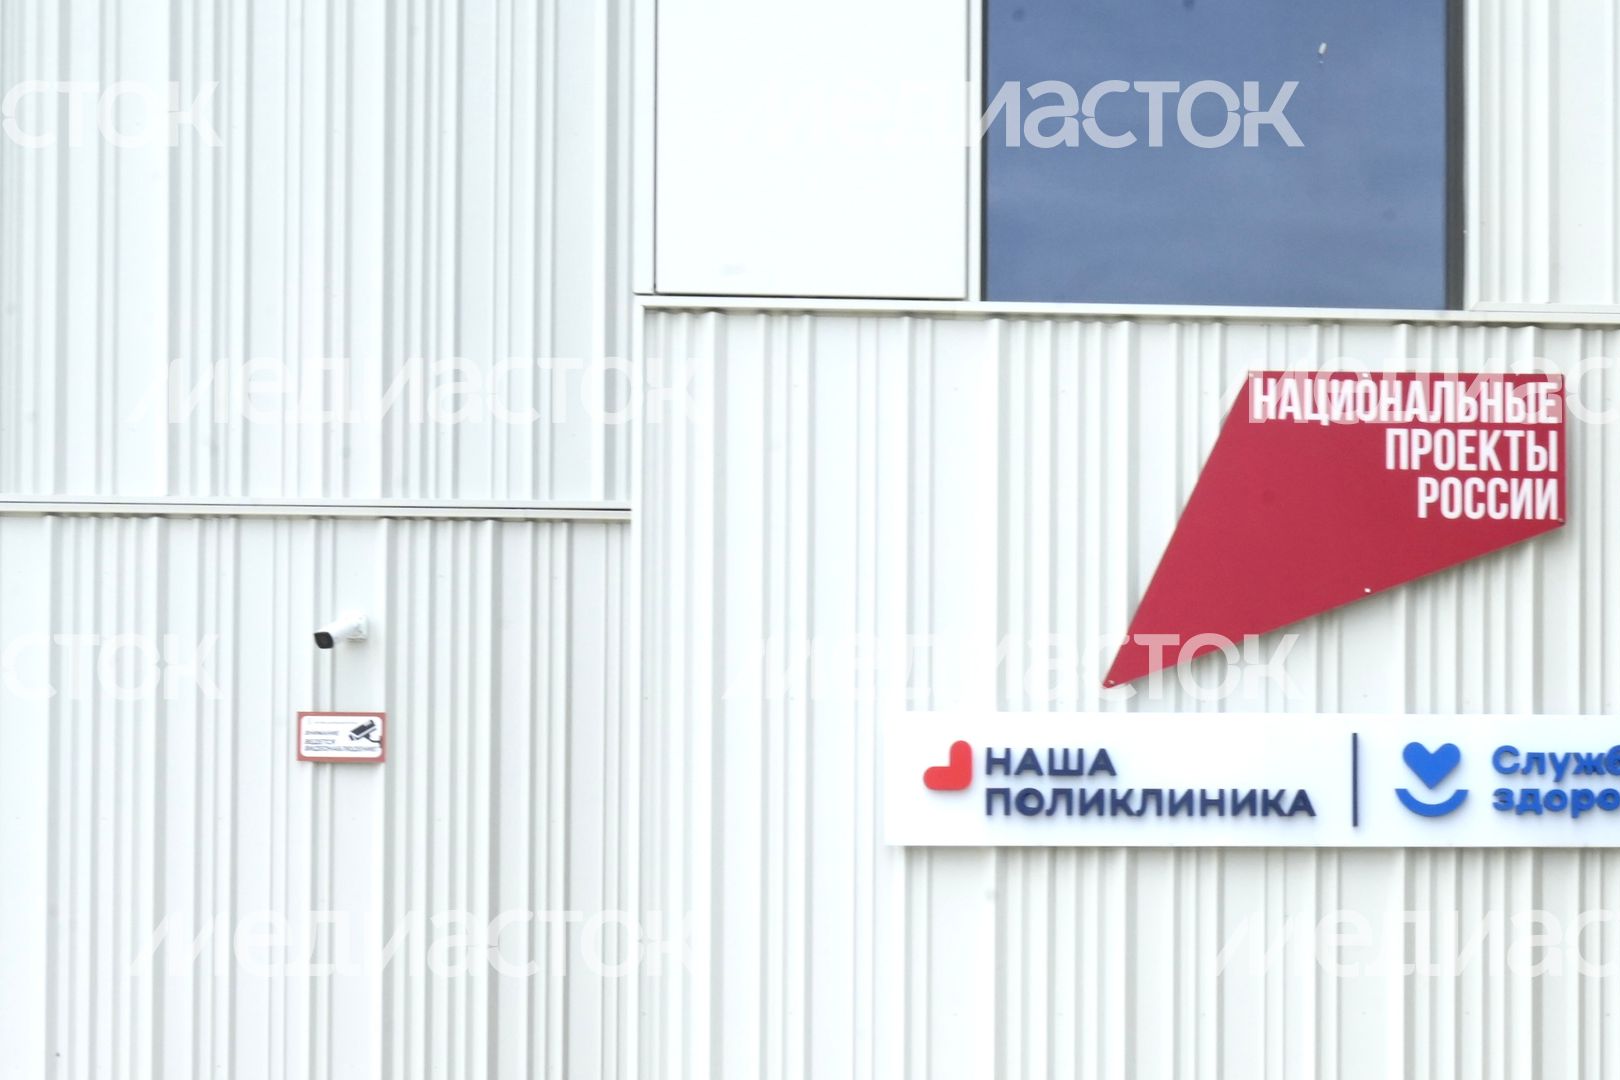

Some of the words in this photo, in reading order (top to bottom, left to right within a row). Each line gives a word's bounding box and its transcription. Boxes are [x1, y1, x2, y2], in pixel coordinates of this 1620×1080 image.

[1253, 377, 1558, 426] НАЦИОНАЛЬНЫЕ
[1386, 428, 1558, 472] ПРОЕКТЫ
[1417, 476, 1558, 520] РОССИИ
[985, 747, 1117, 777] НАША
[985, 787, 1316, 817] ПОЛИКЛИНИКА
